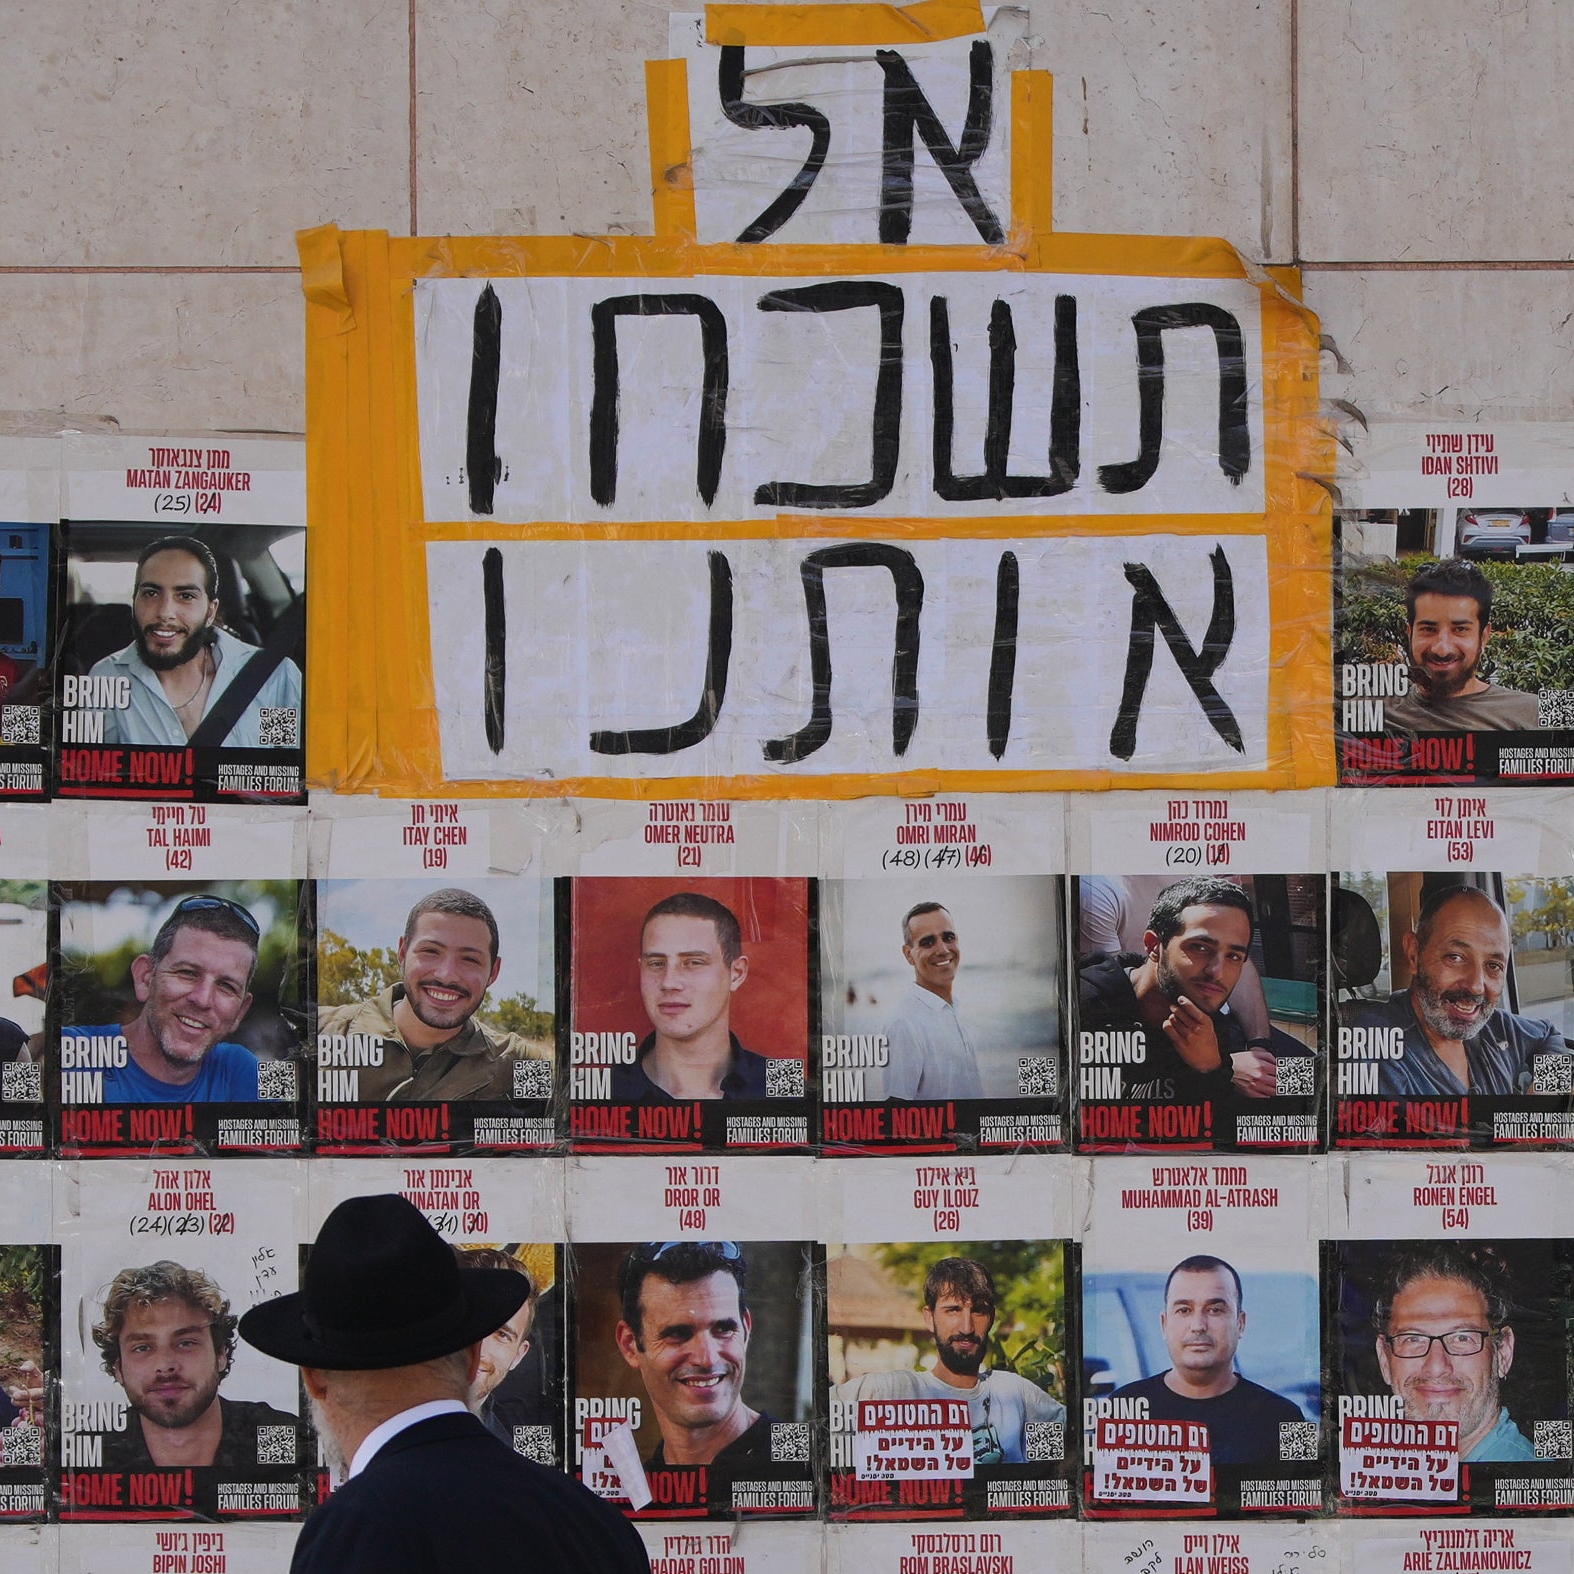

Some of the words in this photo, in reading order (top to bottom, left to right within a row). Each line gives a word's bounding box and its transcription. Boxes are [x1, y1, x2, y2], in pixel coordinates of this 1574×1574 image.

[718, 39, 1006, 245] אל
[467, 280, 1251, 514] תשכחו
[1421, 456, 1454, 476] IDAN
[1456, 455, 1500, 475] SHTIVI
[127, 469, 170, 488] MATAN
[174, 471, 250, 491] ZANGAUKER
[483, 543, 1246, 762] אותנו
[12, 763, 43, 774] MISSING
[7, 774, 43, 790] FORUM
[147, 828, 170, 848] TAL
[173, 828, 212, 847] HAIMI
[403, 826, 431, 846] ITAY
[433, 825, 468, 846] CHEN
[644, 824, 682, 845] OMER
[684, 824, 736, 845] NEUTRA
[896, 825, 931, 845] OMRI
[933, 824, 977, 844] MIRAN
[1149, 822, 1202, 842] NIMROD
[1204, 821, 1247, 842] COHEN
[1426, 819, 1464, 839] EITAN
[1466, 820, 1495, 839] LEVI
[166, 849, 193, 870] (42)
[148, 1192, 183, 1212] ALON
[185, 1191, 218, 1212] OHEL
[464, 1192, 480, 1210] OR
[664, 1187, 700, 1208] DROR
[703, 1187, 722, 1207] OR
[914, 1189, 940, 1209] GUY
[943, 1188, 980, 1209] ILOUZ
[1121, 1189, 1203, 1209] MUHAMMAD
[1205, 1188, 1280, 1208] AL-ATRASH
[1413, 1187, 1457, 1207] RONEN
[1458, 1185, 1498, 1206] ENGEL
[933, 1210, 961, 1232] (26)
[1442, 1208, 1470, 1229] (54)
[153, 1554, 188, 1574] BIPIN
[191, 1554, 227, 1574] JOSHI
[1403, 1550, 1433, 1571] ARIE
[1435, 1550, 1532, 1571] ZALMANOWICZ
